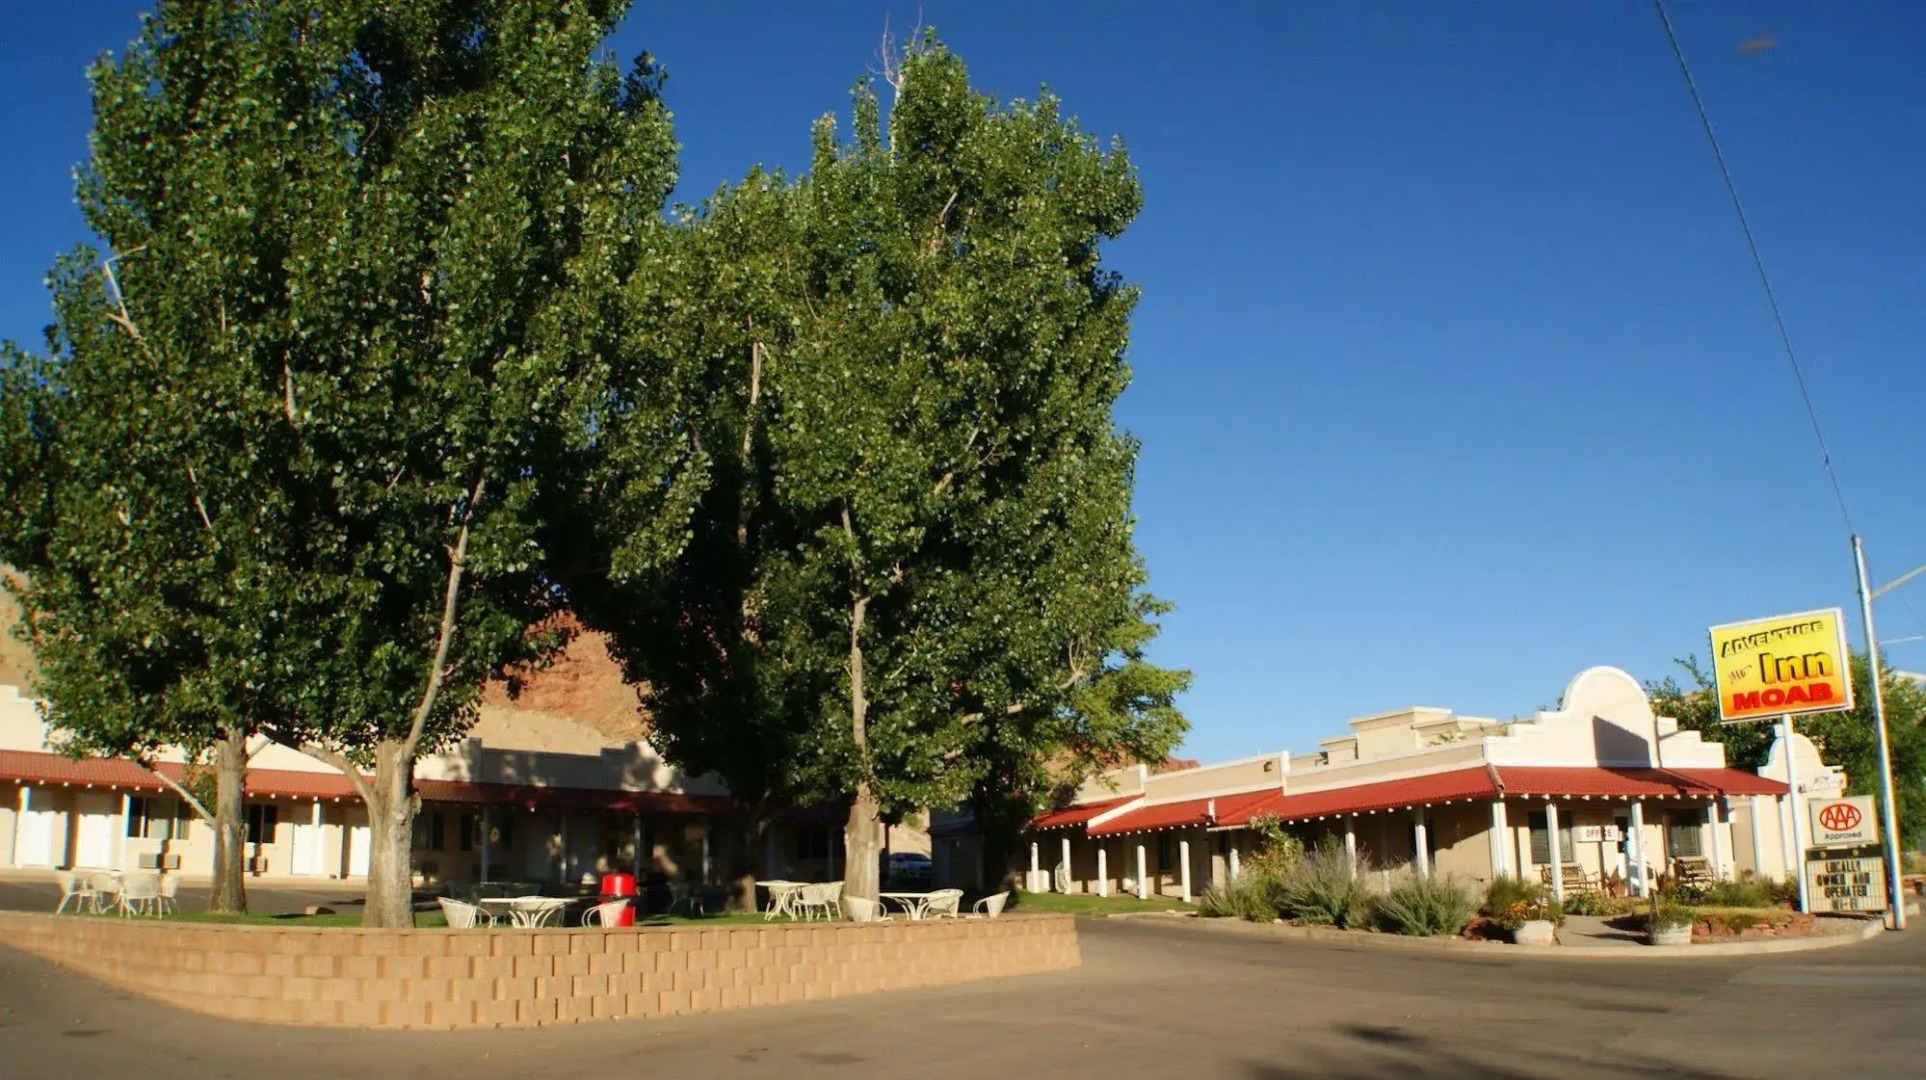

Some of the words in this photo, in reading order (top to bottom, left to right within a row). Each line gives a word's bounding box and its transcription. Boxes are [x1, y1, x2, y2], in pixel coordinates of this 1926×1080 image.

[1721, 620, 1825, 658] ADVENTURE
[1758, 651, 1834, 685] Inn
[1732, 682, 1834, 711] MOAB
[1822, 804, 1860, 830] AAA
[1586, 829, 1612, 838] OFFCE
[1824, 831, 1862, 840] Approved
